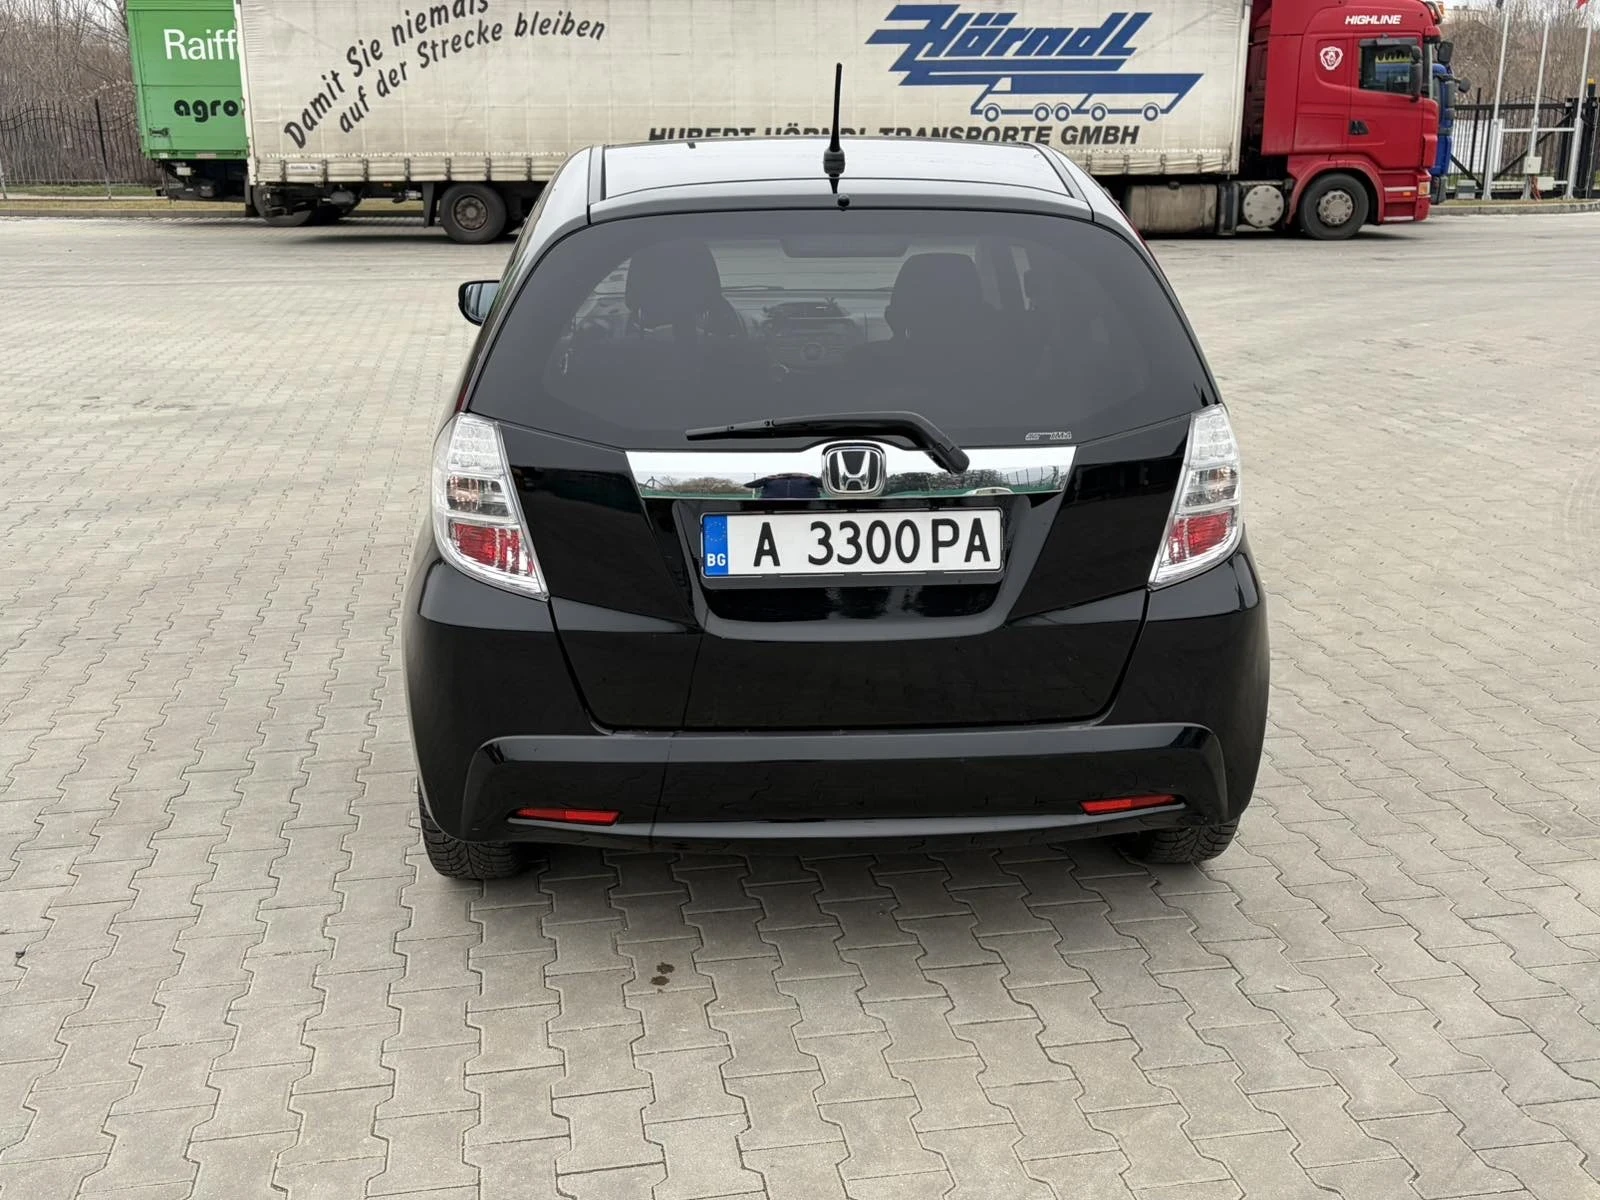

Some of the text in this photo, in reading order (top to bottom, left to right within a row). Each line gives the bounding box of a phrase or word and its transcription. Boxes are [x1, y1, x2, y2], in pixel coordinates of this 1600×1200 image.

[1345, 15, 1402, 25] HIGHLINE
[163, 28, 239, 60] Raiff
[339, 10, 605, 133] auf der Strecke bleiben
[284, 69, 345, 149] Damit
[346, 38, 383, 77] Sie
[174, 99, 239, 123] agro
[1060, 126, 1140, 145] GMBH
[753, 521, 781, 567] A
[707, 553, 727, 567] BG
